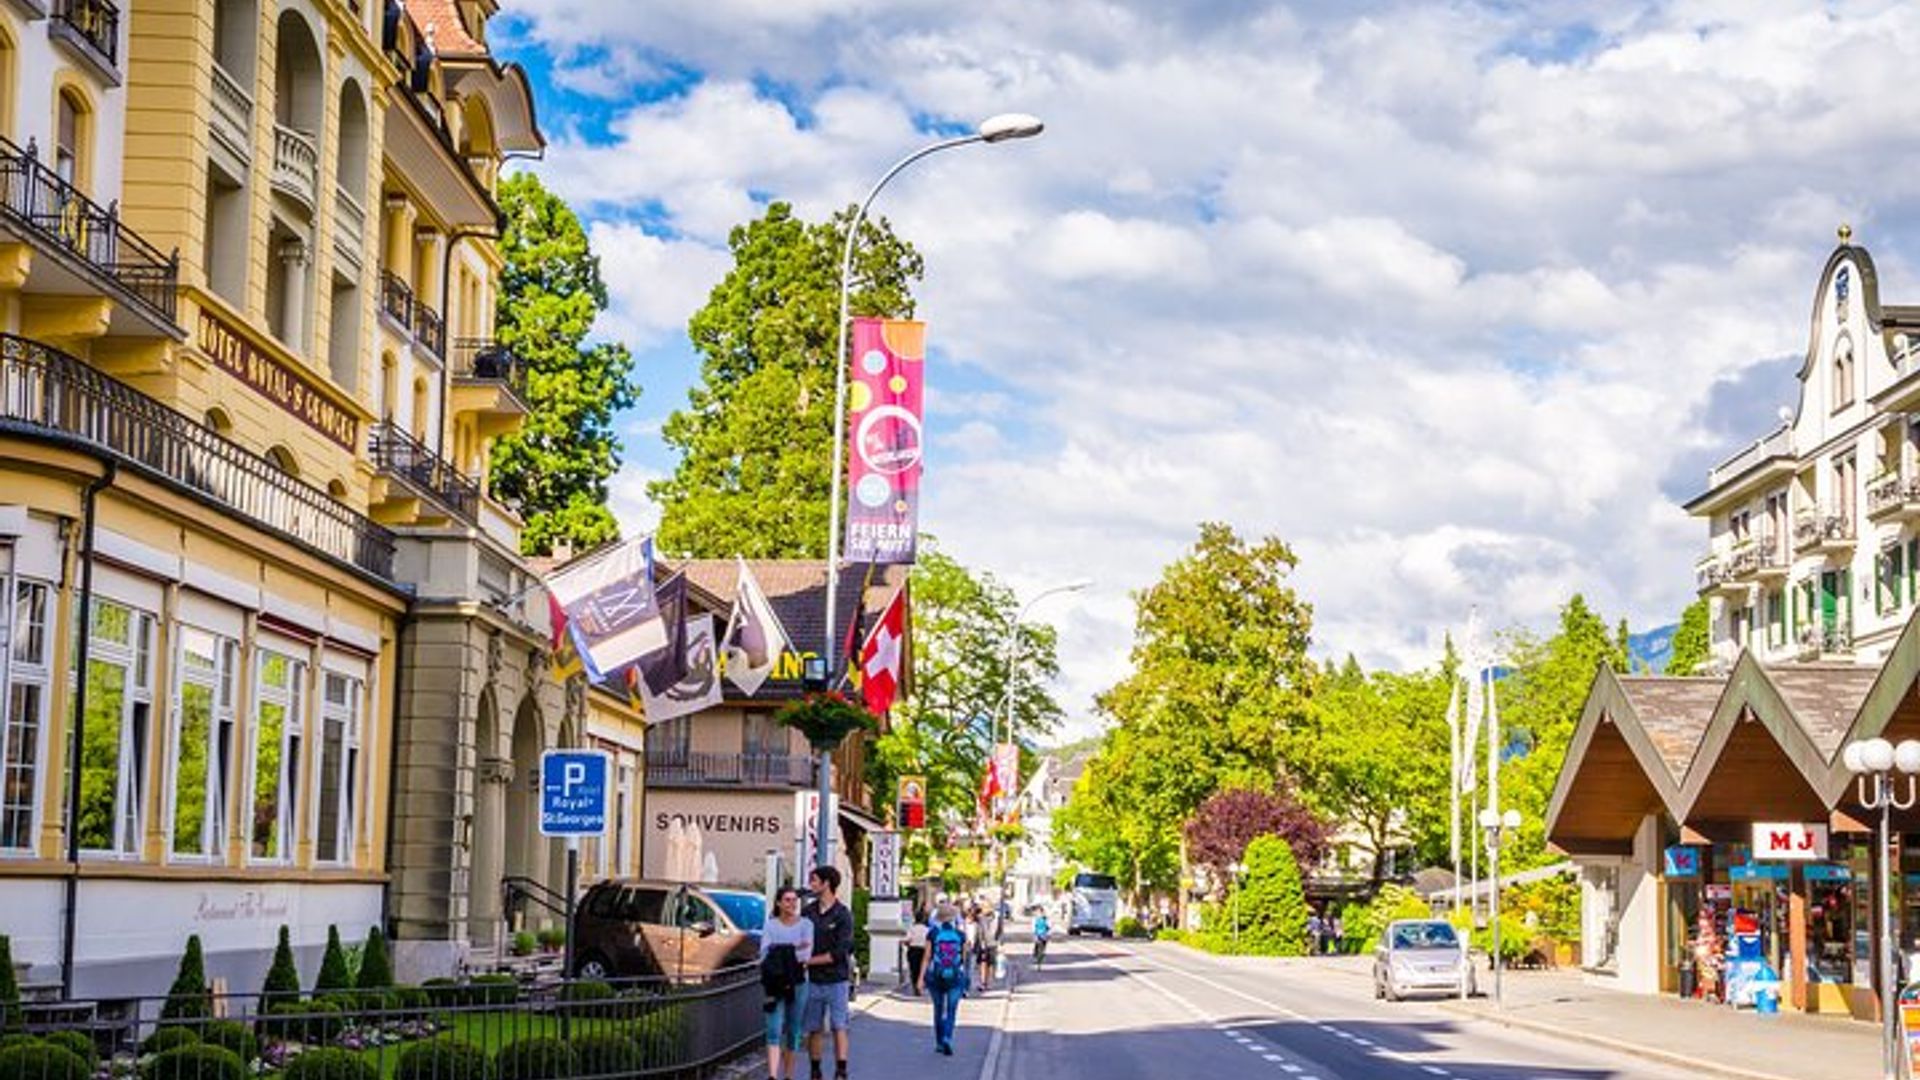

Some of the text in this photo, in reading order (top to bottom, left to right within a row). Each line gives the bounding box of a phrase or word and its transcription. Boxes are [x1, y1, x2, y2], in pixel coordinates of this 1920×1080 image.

[850, 523, 911, 538] FEIERN
[565, 763, 585, 797] P
[656, 813, 780, 834] SOUVENIRS
